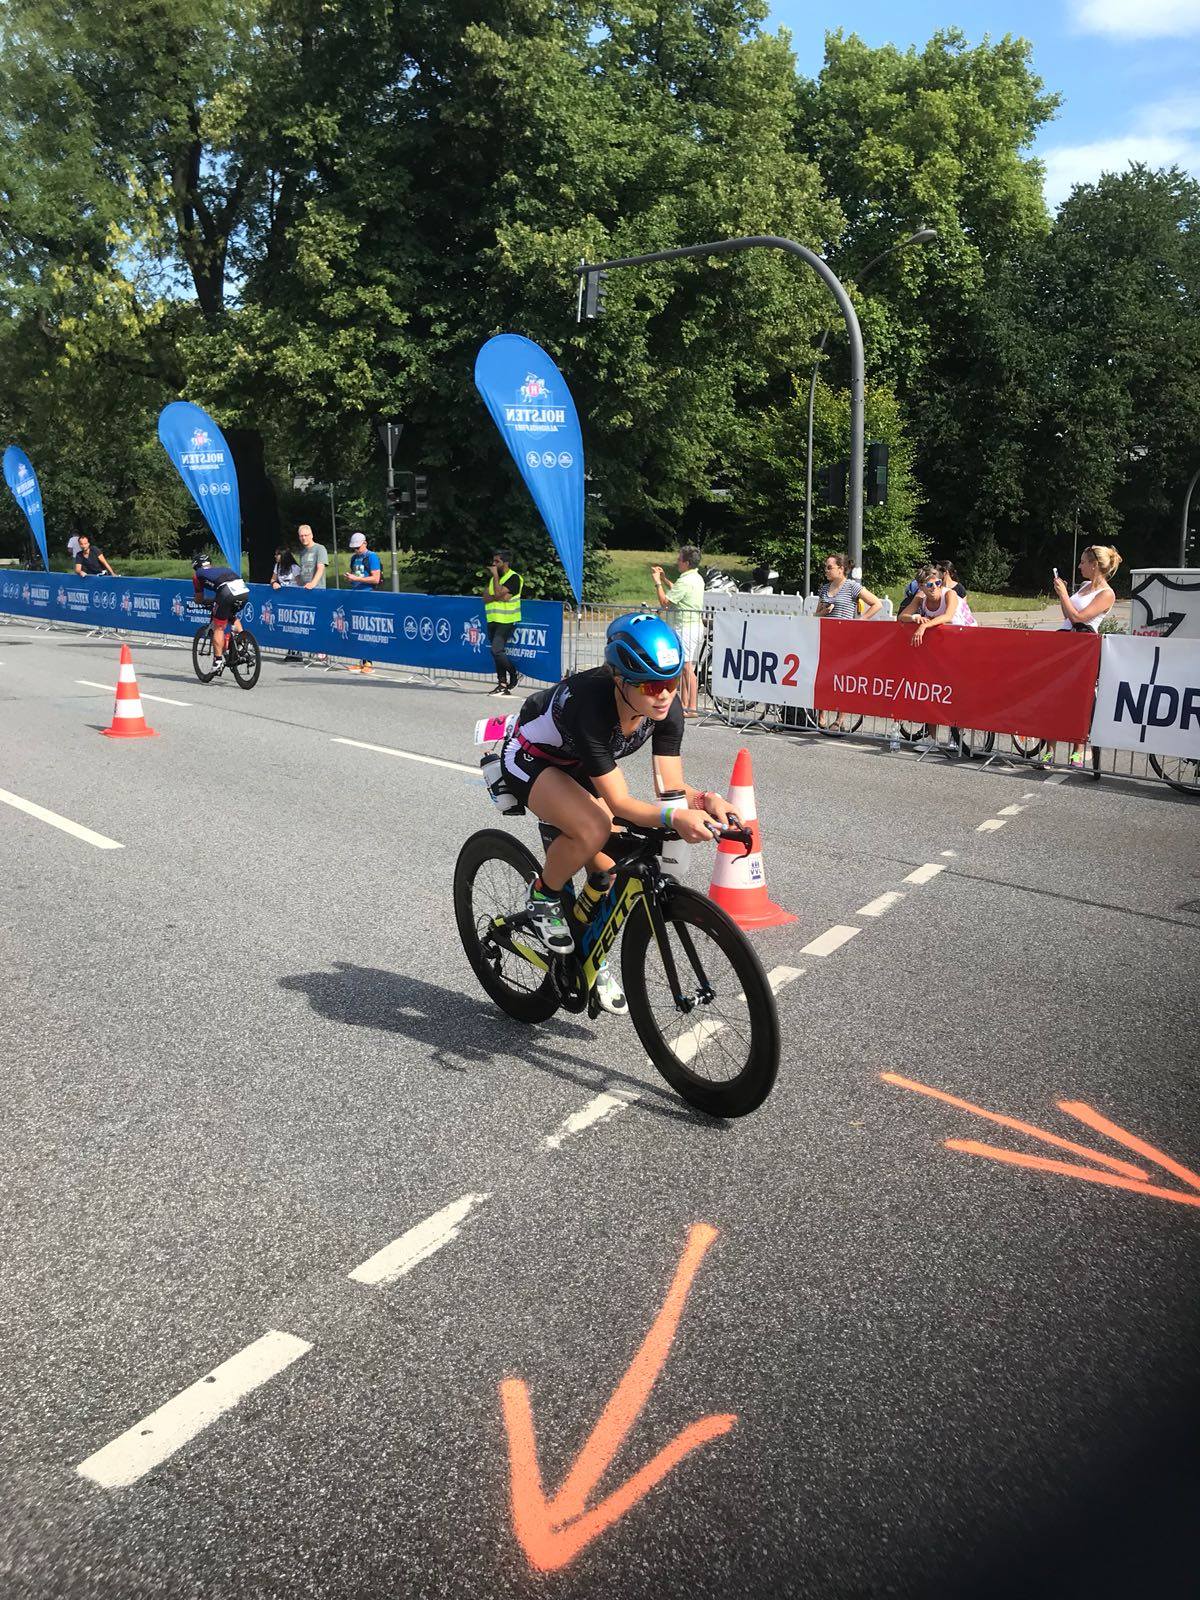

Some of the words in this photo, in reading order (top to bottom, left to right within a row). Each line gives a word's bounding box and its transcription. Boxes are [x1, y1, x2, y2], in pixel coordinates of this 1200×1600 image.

[278, 608, 316, 626] HOLSTEN
[351, 615, 394, 633] HOLSTEN
[507, 627, 547, 647] STEN
[722, 647, 779, 685] NDR
[781, 653, 801, 687] 2
[833, 674, 868, 695] NDR
[872, 677, 953, 705] DE/NDR2
[1114, 681, 1200, 730] NDR
